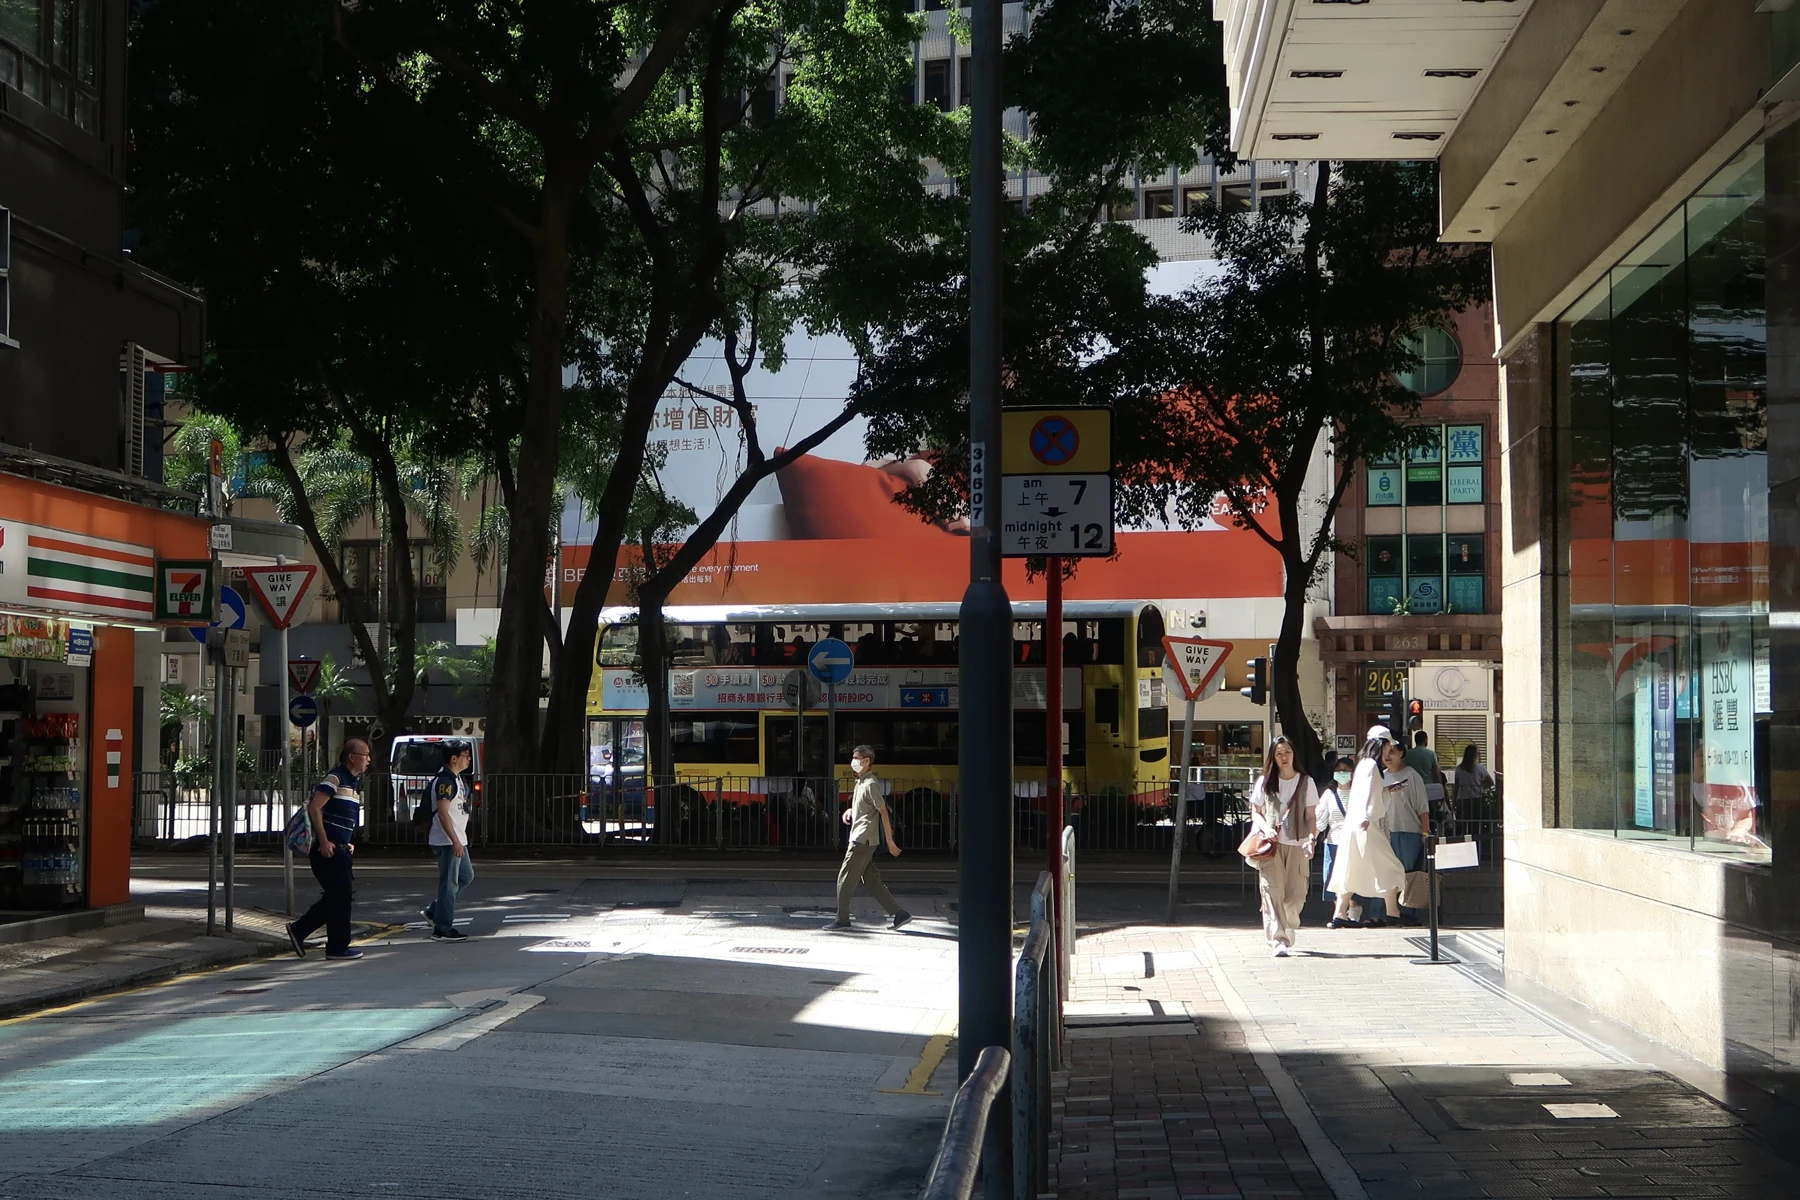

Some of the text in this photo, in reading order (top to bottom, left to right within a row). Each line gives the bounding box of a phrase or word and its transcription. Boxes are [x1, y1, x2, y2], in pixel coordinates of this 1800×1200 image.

[972, 448, 983, 519] 34607
[1023, 479, 1042, 488] am
[1069, 480, 1087, 505] 7
[1453, 487, 1477, 495] PARTY
[1018, 492, 1048, 506] 上午
[1005, 520, 1062, 533] midnight
[1070, 523, 1104, 549] 12
[1018, 536, 1049, 550] 午夜
[564, 568, 587, 582] BE
[699, 564, 721, 574] every
[268, 574, 292, 583] GIVE
[269, 584, 292, 592] WAY
[1393, 637, 1419, 649] 263
[1185, 646, 1209, 656] GIVE
[1186, 655, 1208, 665] WAY
[704, 673, 718, 687] $0
[720, 673, 751, 686] 手續費
[761, 673, 775, 686] $0
[1368, 671, 1405, 691] 263
[1711, 660, 1739, 694] HSBC
[1337, 737, 1355, 748] 263
[439, 783, 453, 796] 84
